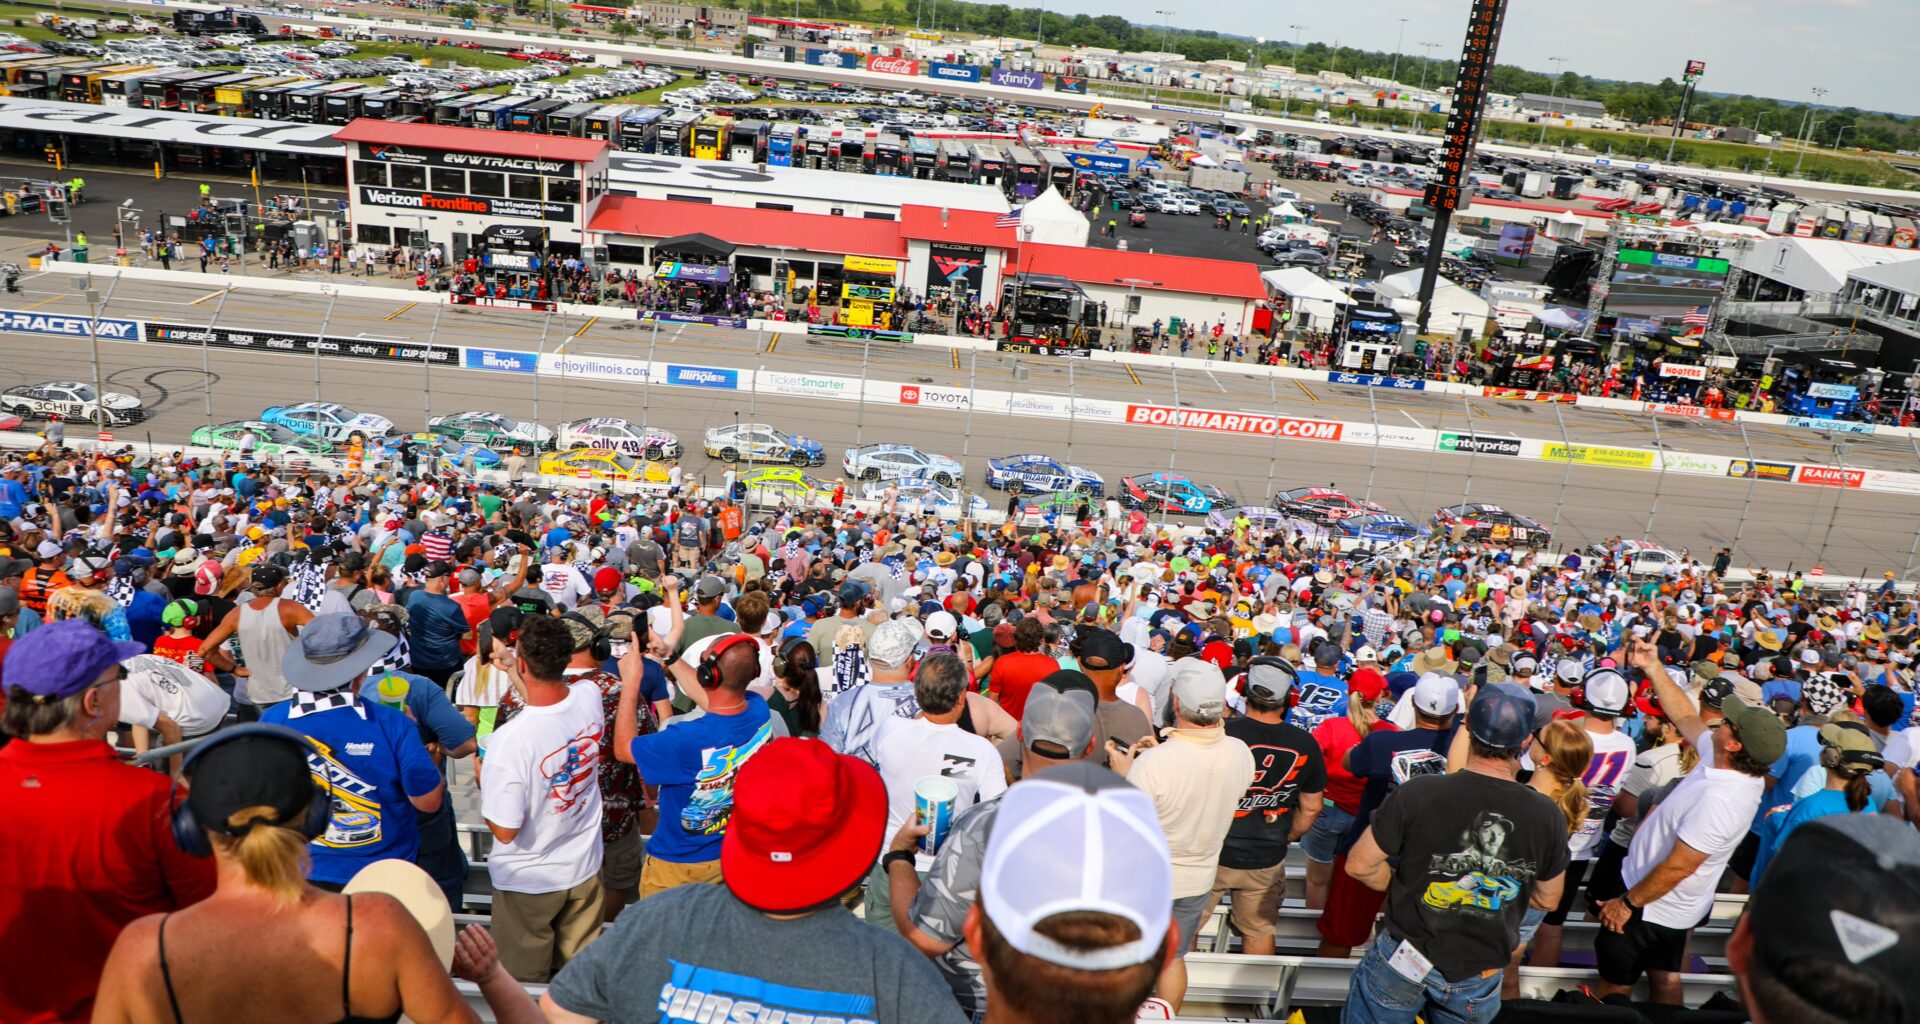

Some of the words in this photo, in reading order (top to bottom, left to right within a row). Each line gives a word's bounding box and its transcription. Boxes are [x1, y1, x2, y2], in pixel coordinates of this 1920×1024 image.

[1482, 11, 1493, 22] 10
[1474, 25, 1489, 36] 20
[871, 56, 913, 75] Coca-Cola
[937, 67, 971, 79] GEICO
[998, 71, 1036, 87] xfinity
[1447, 121, 1455, 129] 11
[1460, 121, 1469, 132] 2
[1452, 135, 1466, 146] 42
[1447, 161, 1460, 172] 48
[1436, 174, 1443, 182] 15
[1449, 175, 1457, 185] 6
[512, 202, 541, 210] network
[541, 204, 565, 212] choice
[1429, 196, 1438, 206] 2
[1444, 199, 1455, 209] 18
[499, 206, 520, 215] public
[932, 243, 971, 252] WELCOME
[491, 254, 529, 268] MOOSE
[1657, 254, 1695, 264] GEICO
[680, 266, 705, 275] Nurtec
[1364, 321, 1386, 331] Ford
[170, 330, 187, 340] CUP
[187, 332, 217, 342] SERES
[228, 333, 254, 344] BUSCH
[266, 337, 294, 349] Coca-Cola
[350, 344, 378, 356] xfinity
[401, 348, 418, 358] CUP
[418, 350, 448, 361] SRIES
[1003, 343, 1032, 354] 3CHI
[1038, 347, 1049, 356] 8
[482, 355, 521, 369] illinois
[554, 360, 650, 376] enjoyillinois.com
[1665, 366, 1702, 378] HOOTERS
[769, 373, 846, 390] TicketSmarter
[1337, 372, 1360, 384] Ford
[1371, 376, 1384, 386] 10
[1394, 378, 1417, 389] Ford
[1812, 385, 1850, 397] Acronis
[924, 392, 969, 404] TOYOTA
[34, 401, 67, 412] 3CHI
[69, 404, 84, 417] 8
[1006, 399, 1054, 411] FulfordHomes
[1663, 404, 1700, 416] HOOTERS
[1132, 407, 1338, 440] BOMMARITO.COM
[323, 425, 343, 438] 17
[592, 438, 619, 451] ally
[621, 440, 639, 453] 48
[1440, 437, 1520, 454] enterprise
[766, 446, 787, 458] 42
[911, 467, 929, 479] 4
[1022, 473, 1051, 483] WIZARD
[1803, 468, 1861, 481] RANKEN
[1185, 497, 1206, 510] 43
[1512, 527, 1528, 540] 18
[1299, 682, 1342, 710] 12
[695, 745, 733, 781] 5
[1247, 744, 1299, 792] 9
[1583, 750, 1628, 787] 11
